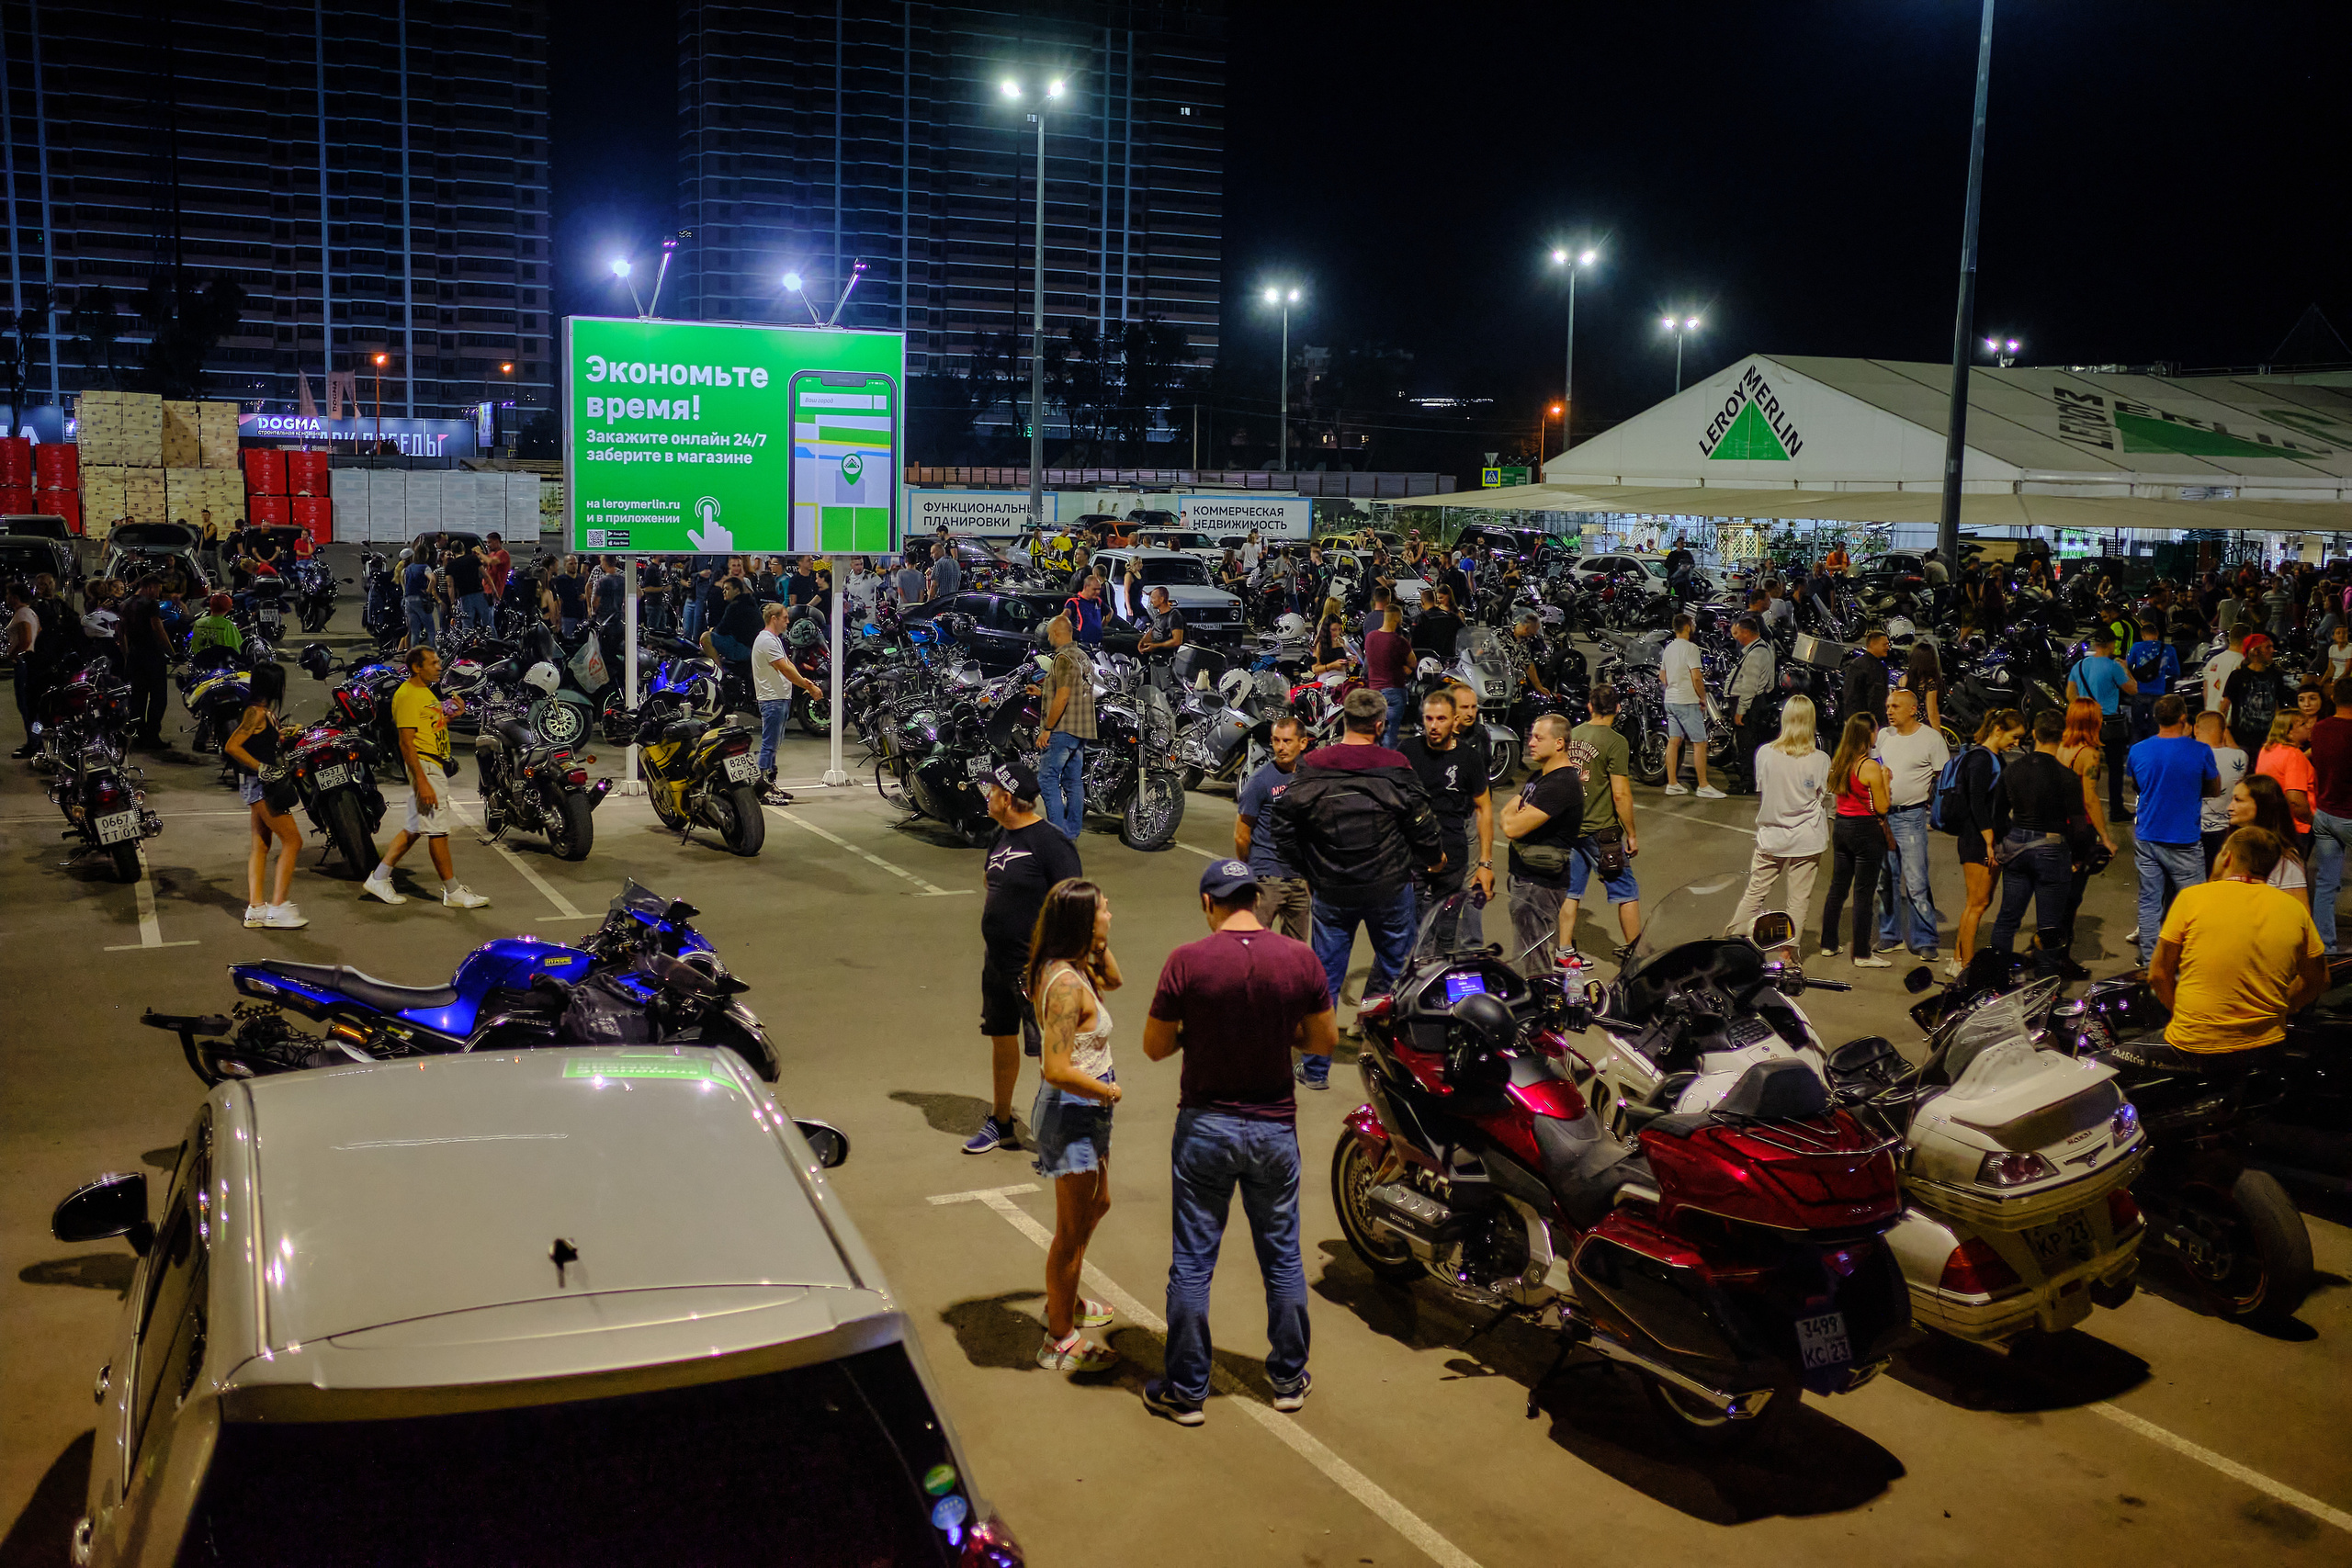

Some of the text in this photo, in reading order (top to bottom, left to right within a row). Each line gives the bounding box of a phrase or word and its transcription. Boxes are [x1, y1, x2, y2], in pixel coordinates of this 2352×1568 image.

[585, 355, 769, 389] Экономьте
[586, 395, 701, 425] время!
[1699, 365, 1804, 458] LEROY MERLIN
[257, 417, 321, 431] DOGMA
[586, 429, 767, 448] Закажите онлайн 24/7
[586, 447, 753, 465] заберите в магазине
[586, 498, 681, 512] на leroymerlin.ru
[923, 502, 1045, 514] ФУНКЦИОНАЛЬН
[1193, 506, 1284, 517] КОММЕРЧЕСКАЯ
[586, 513, 681, 525] и в приложении
[923, 516, 1011, 527] ПЛАНИРОВКИ
[1193, 519, 1288, 531] НЕДВИЖИМОСТЬ
[319, 766, 339, 779] 9537
[746, 765, 759, 776] 23
[334, 774, 346, 784] 23
[101, 813, 129, 829] 0667
[122, 826, 138, 838] 01
[1802, 1315, 1838, 1338] 3499
